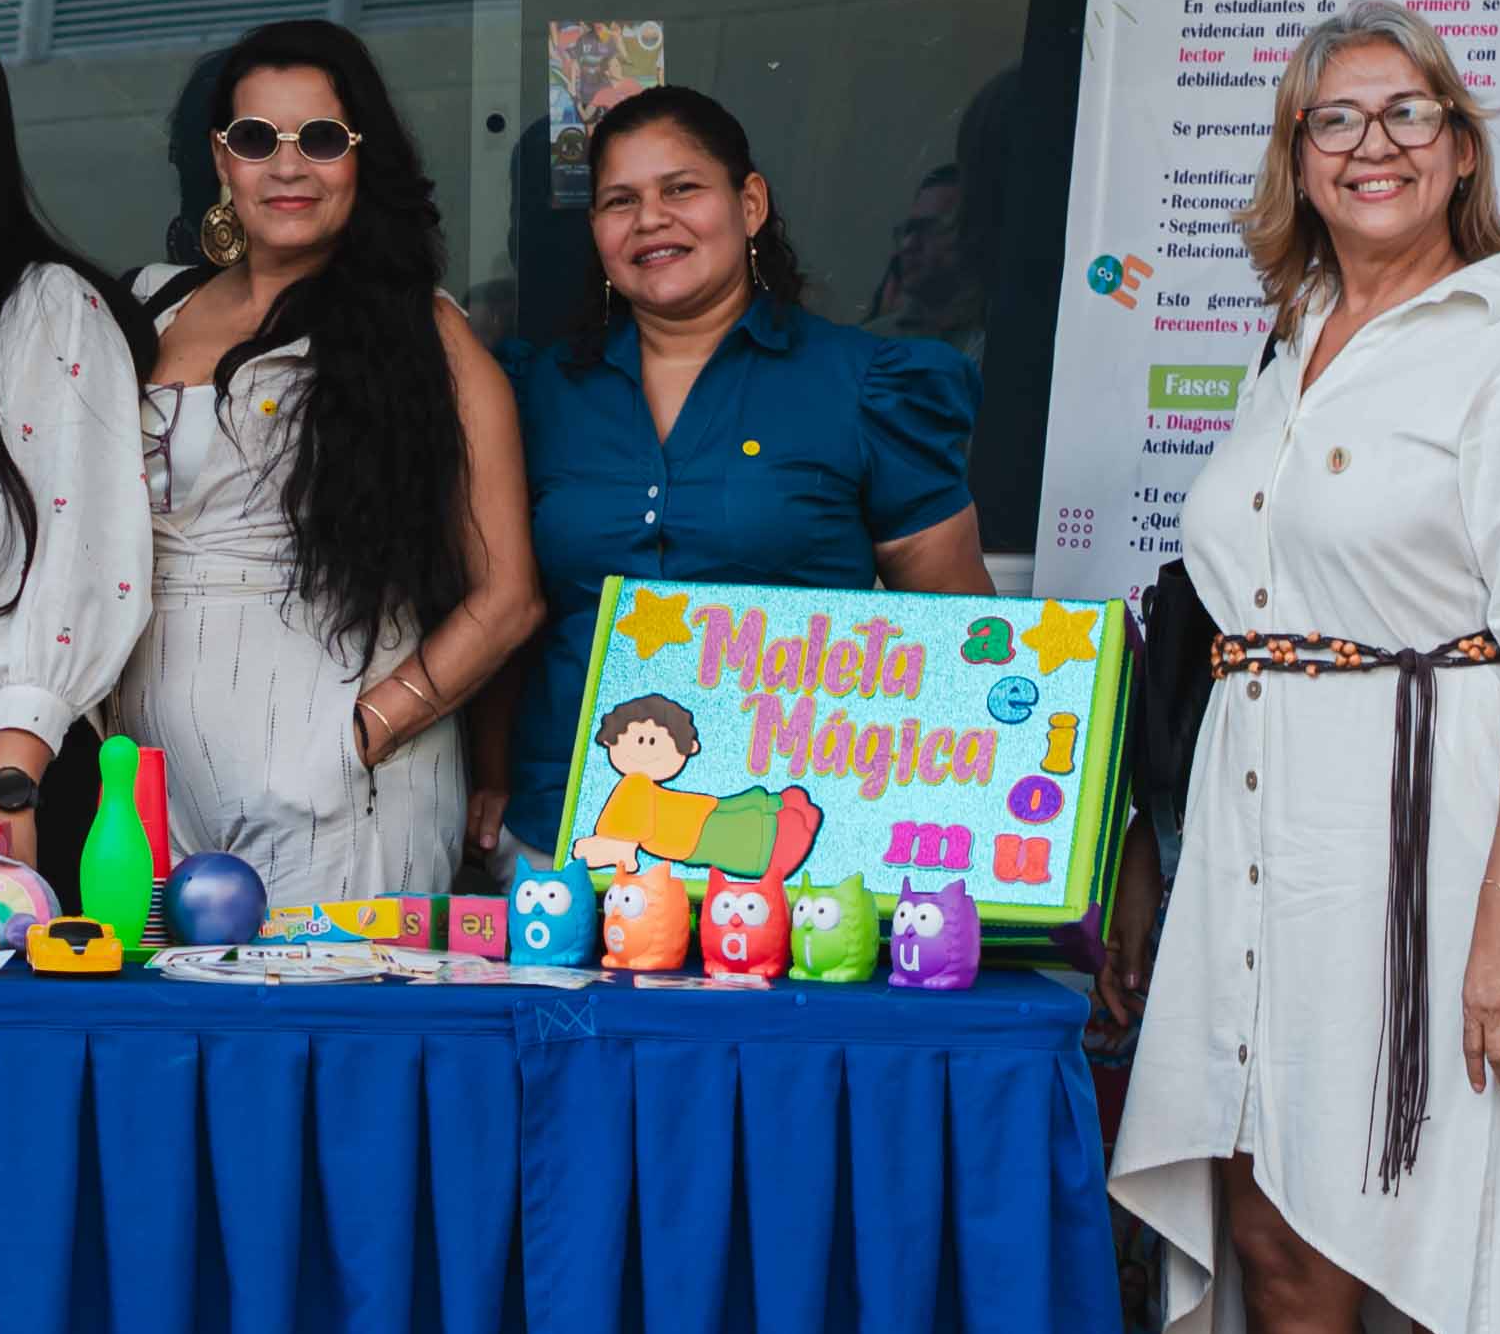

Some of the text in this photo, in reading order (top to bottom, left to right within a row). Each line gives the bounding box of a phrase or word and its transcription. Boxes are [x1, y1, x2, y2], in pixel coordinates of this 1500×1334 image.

[1482, 0, 1500, 11] se
[1181, 22, 1264, 38] evidencian
[1434, 24, 1498, 43] proceso
[1179, 47, 1225, 63] lector
[1467, 49, 1496, 61] con
[1177, 71, 1266, 87] debilidades
[1173, 121, 1191, 135] Se
[1173, 169, 1256, 186] Identificar
[1156, 291, 1190, 307] Esto
[1154, 315, 1239, 333] frecuentes
[1165, 372, 1230, 397] Fases
[1142, 438, 1214, 455] Actividad
[960, 616, 1015, 666] a
[691, 604, 926, 701] Maleta
[987, 675, 1039, 725] e
[741, 692, 999, 801] Mágica
[1040, 712, 1077, 774] i
[883, 820, 1050, 884] m u
[608, 924, 625, 953] e
[721, 932, 748, 962] a
[900, 943, 920, 972] u
